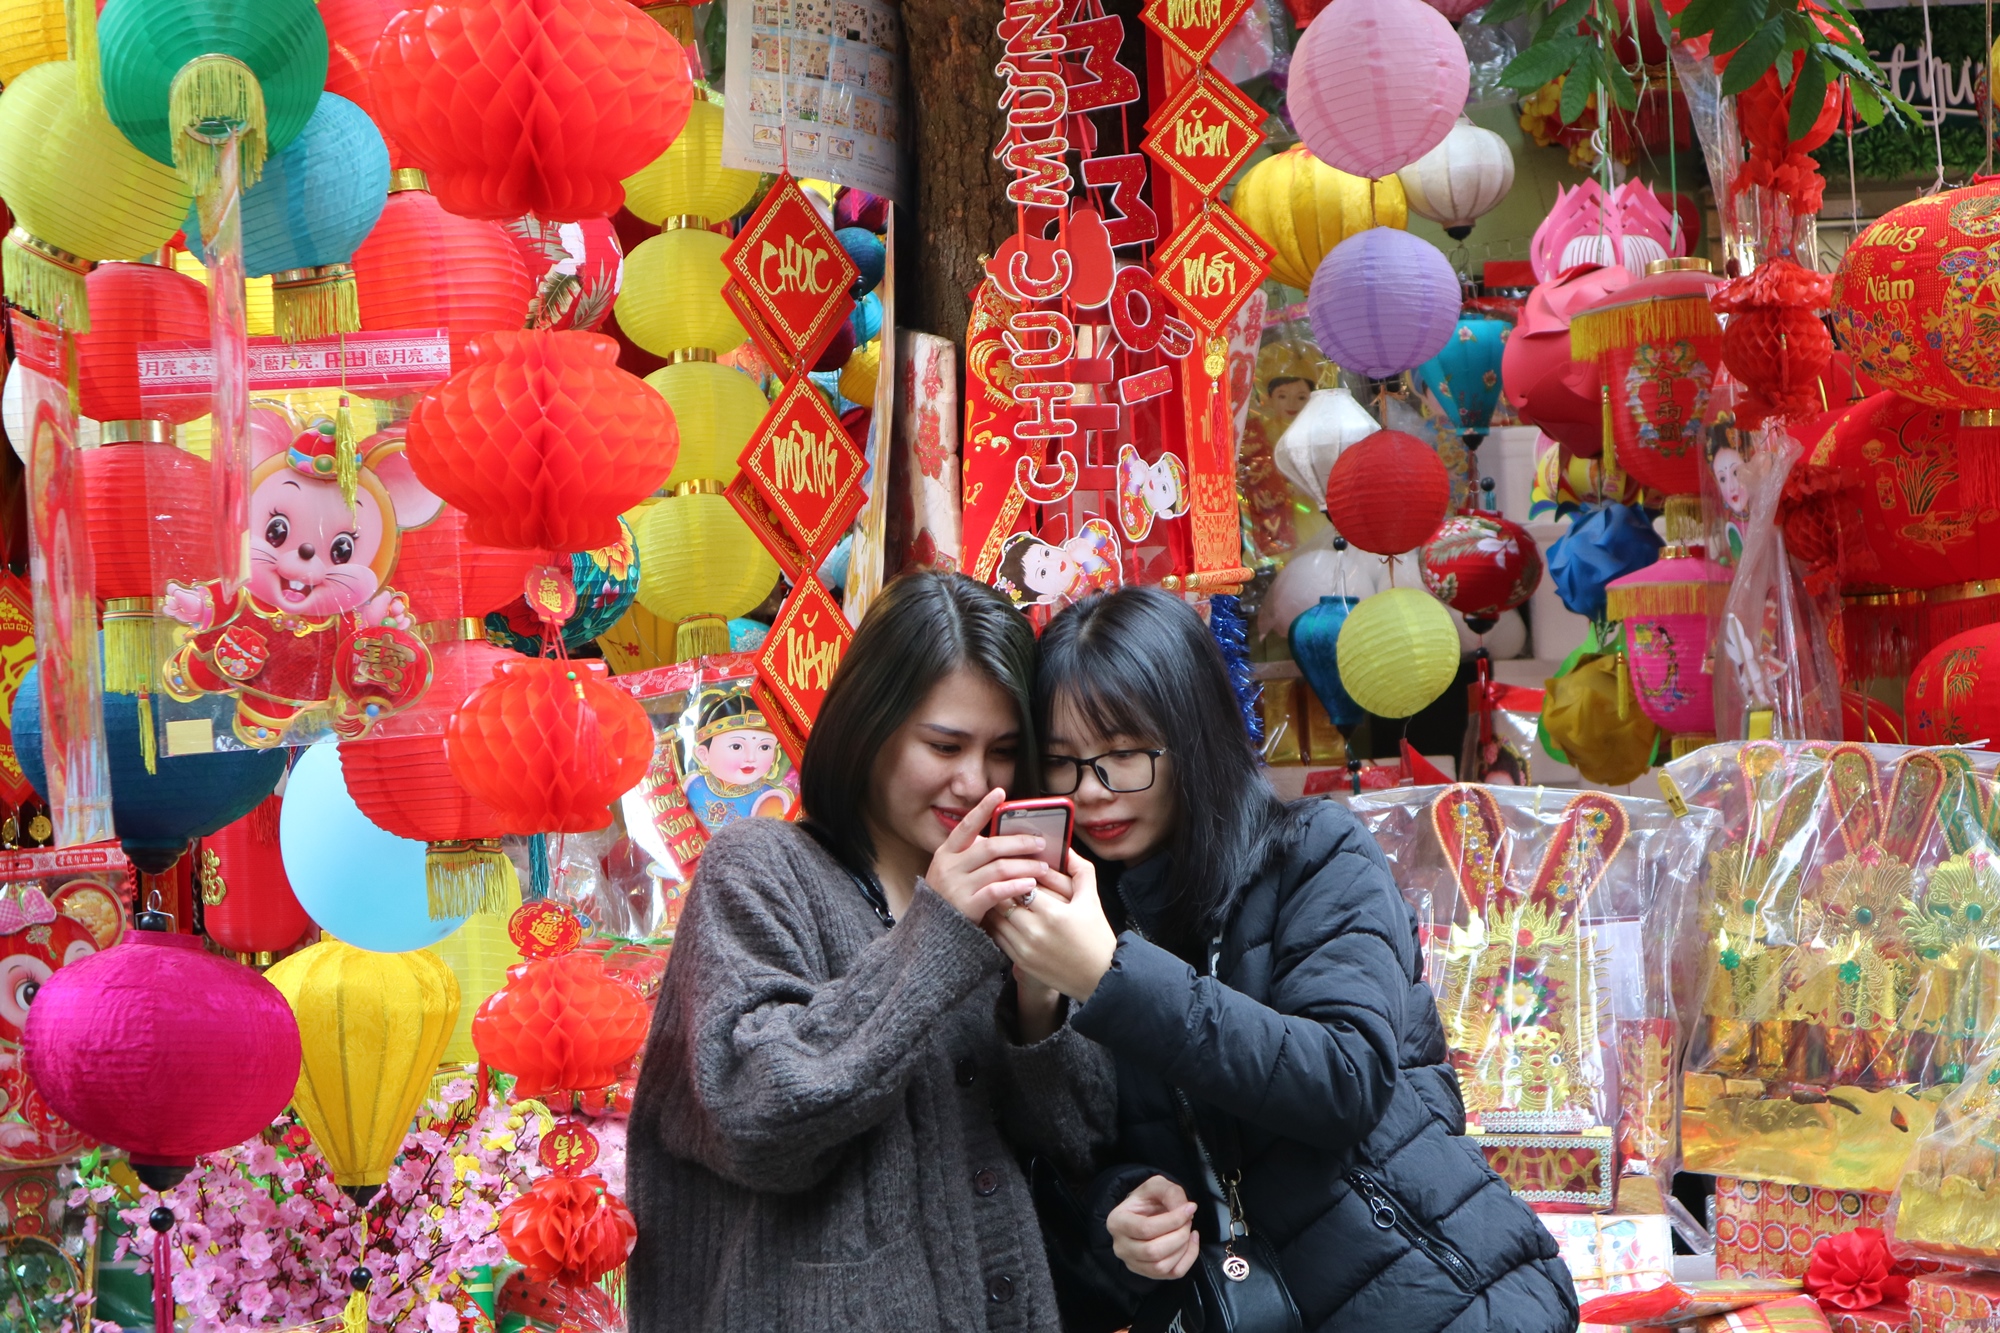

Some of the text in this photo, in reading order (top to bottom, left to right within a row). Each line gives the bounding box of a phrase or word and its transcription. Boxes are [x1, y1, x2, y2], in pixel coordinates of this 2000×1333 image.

[1175, 107, 1231, 158] NĂM
[759, 229, 833, 296] CHÚC
[1865, 275, 1915, 305] Năm
[1002, 249, 1078, 504] CHÚC
[787, 610, 842, 691] NĂM
[656, 812, 696, 843] Năm
[674, 831, 707, 862] Mới
